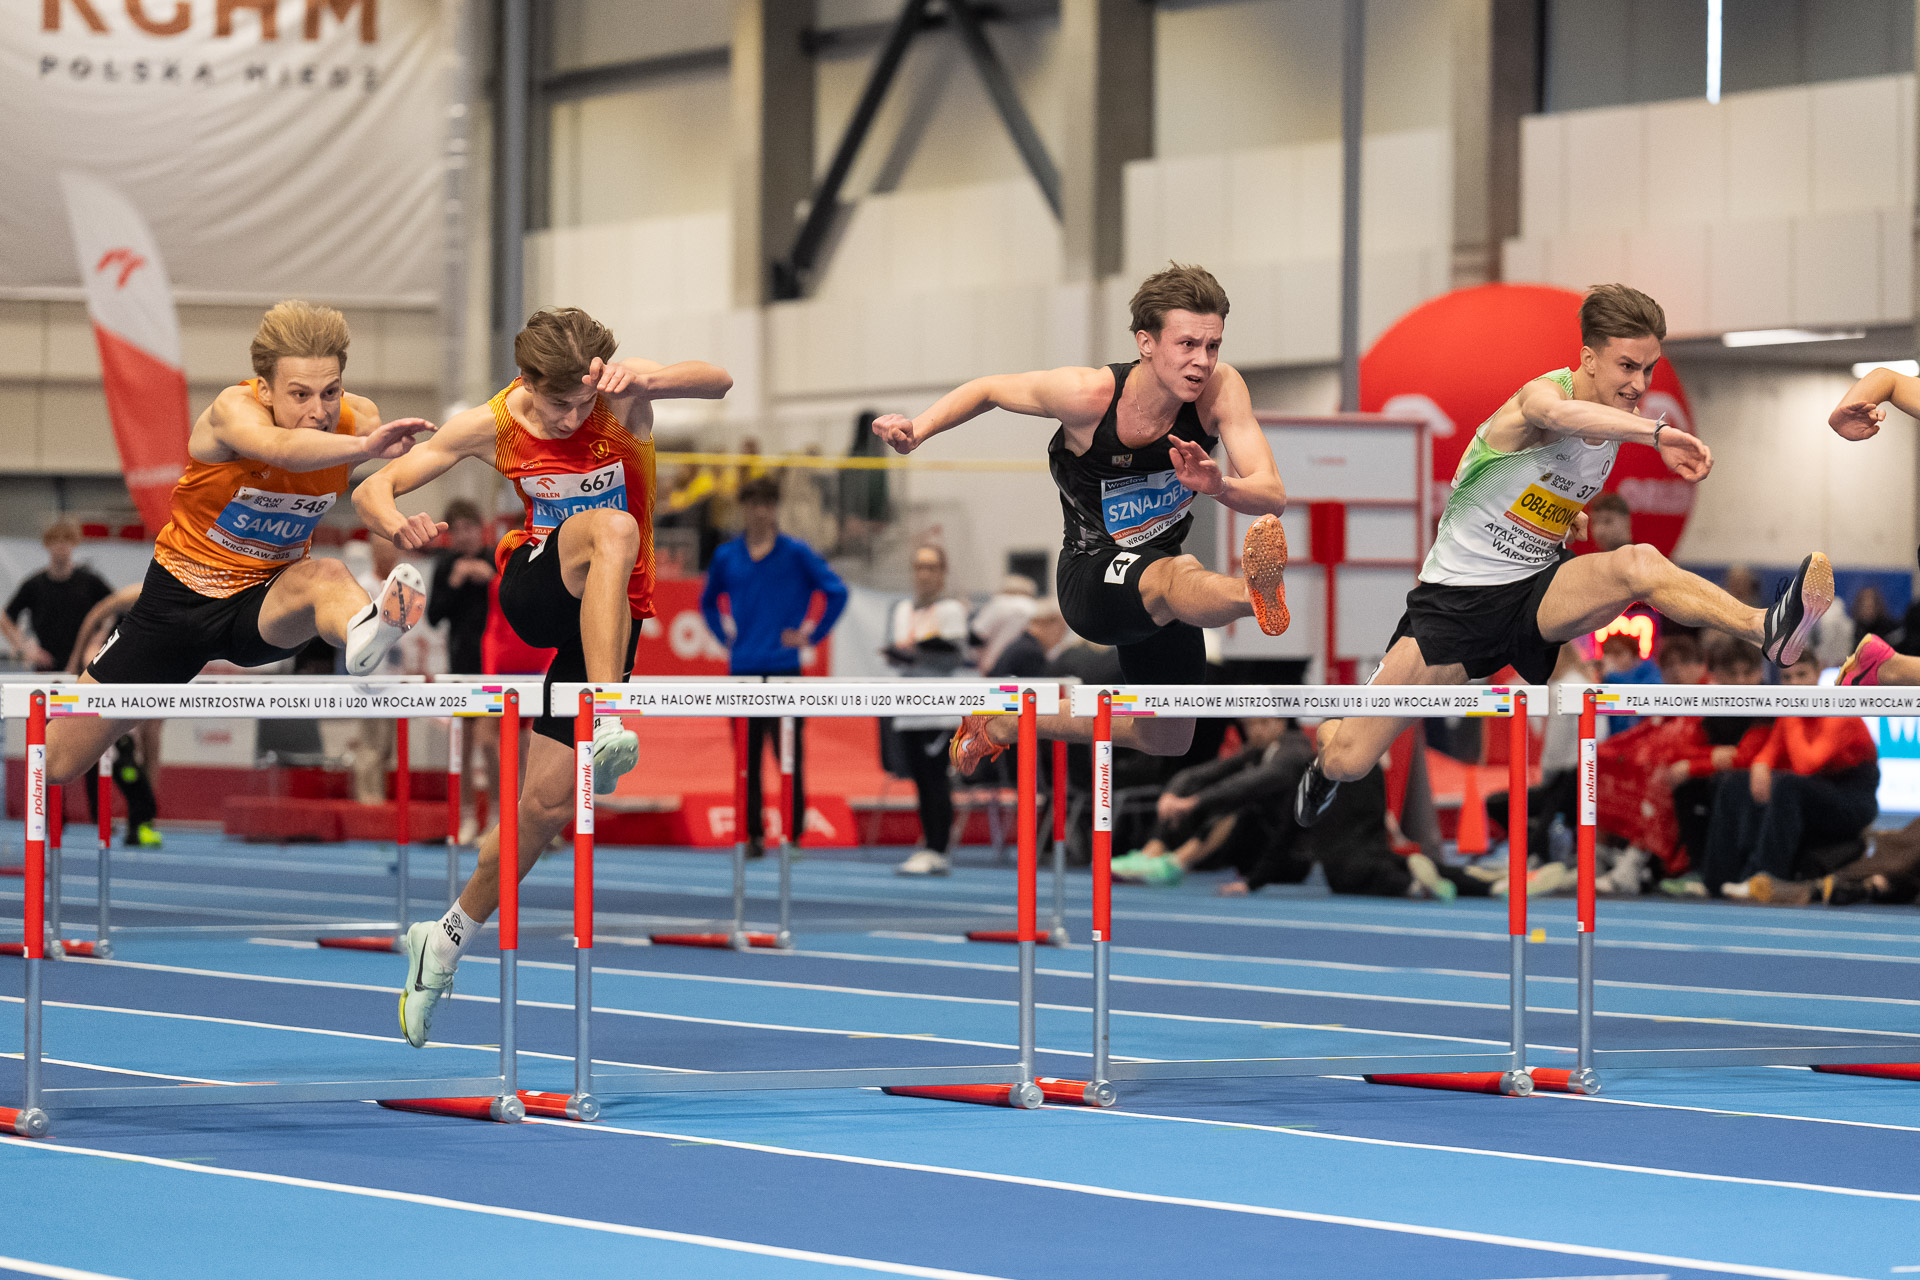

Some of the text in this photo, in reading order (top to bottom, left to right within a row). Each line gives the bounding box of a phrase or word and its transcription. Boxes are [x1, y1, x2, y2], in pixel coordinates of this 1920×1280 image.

[39, 55, 214, 85] POLSKA
[580, 470, 615, 493] 667
[1554, 474, 1576, 487] DOLNY
[255, 495, 285, 504] DOLNY
[1576, 484, 1600, 501] 37
[290, 498, 328, 514] 548
[1484, 522, 1518, 545] ATAK
[221, 538, 271, 559] WROCŁAW
[1112, 557, 1131, 577] 4
[88, 697, 116, 708] PZLA
[122, 697, 175, 708] HALOWE
[180, 697, 265, 708] MISTRZOSTWA
[270, 697, 309, 708] POLSKI
[315, 697, 335, 708] U18
[347, 697, 367, 708] U20
[372, 697, 435, 708] WROCŁAW
[440, 697, 467, 708] 2025
[630, 695, 656, 706] PZLA
[662, 695, 711, 706] HALOWE
[716, 695, 795, 706] MISTRZOSTWA
[800, 695, 837, 706] POLSKI
[842, 695, 861, 706] U18
[871, 695, 891, 706] U20
[895, 695, 955, 706] WROCŁAW
[960, 695, 985, 706] 2025
[1145, 697, 1169, 708] PZLA
[1175, 697, 1221, 708] HALOWE
[1225, 697, 1300, 708] MISTRZOSTWA
[1304, 697, 1339, 708] POLSKI
[1344, 697, 1362, 708] U18
[1371, 697, 1390, 708] U20
[1394, 697, 1450, 708] WROCŁAW
[1454, 697, 1479, 708] 2025
[1627, 697, 1649, 708] PZLA
[1655, 697, 1698, 708] HALOWE
[1702, 697, 1772, 708] MISTRZOSTWA
[1776, 697, 1809, 708] POLSKI
[1812, 697, 1830, 708] U18
[1838, 697, 1857, 708] U20
[1860, 697, 1913, 708] WROCŁAW
[32, 767, 44, 816] polanik
[581, 764, 592, 810] polanik
[1099, 762, 1111, 809] polanik
[1585, 760, 1596, 803] polanik
